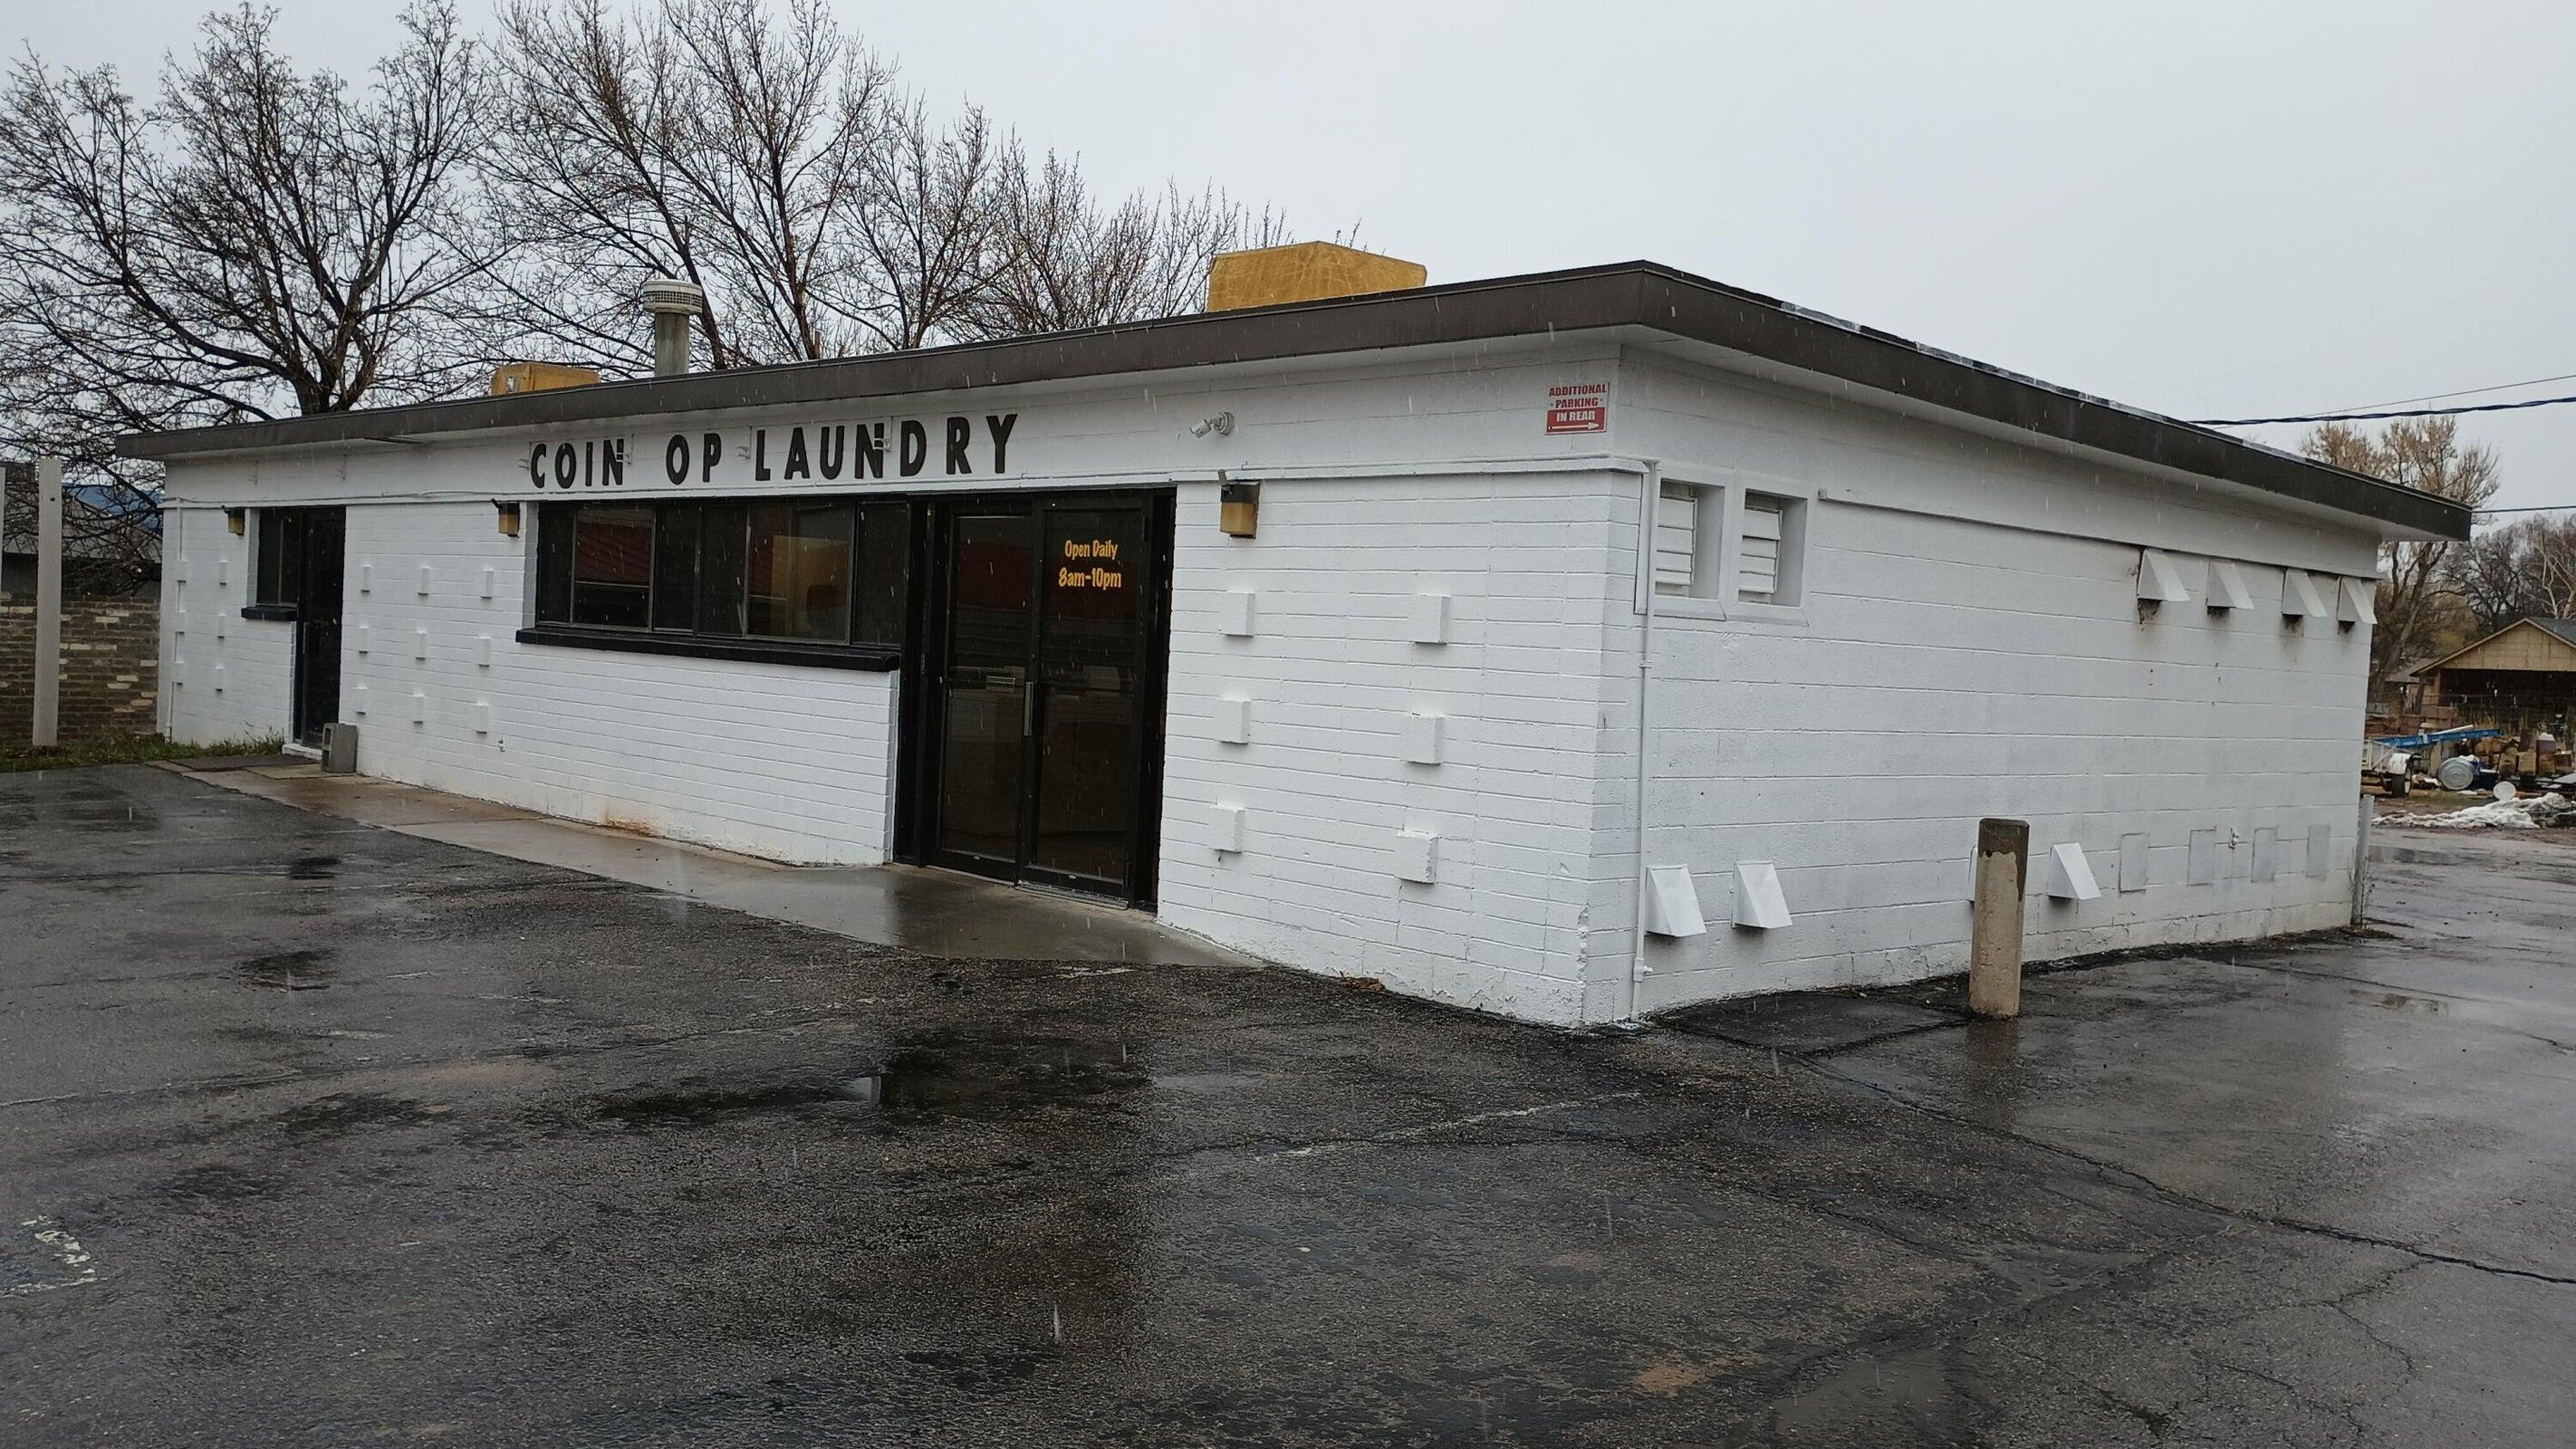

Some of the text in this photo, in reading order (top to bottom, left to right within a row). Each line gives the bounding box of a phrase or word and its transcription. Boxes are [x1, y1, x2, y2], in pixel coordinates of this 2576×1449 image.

[1549, 384, 1607, 397] ADDITIONAL
[1555, 397, 1599, 408] PARKING
[1556, 410, 1596, 422] IN REAR
[531, 413, 1018, 488] COIN OP LAUNDRY
[1064, 540, 1119, 561] Open Daily
[1058, 567, 1121, 590] 8am-10pm
